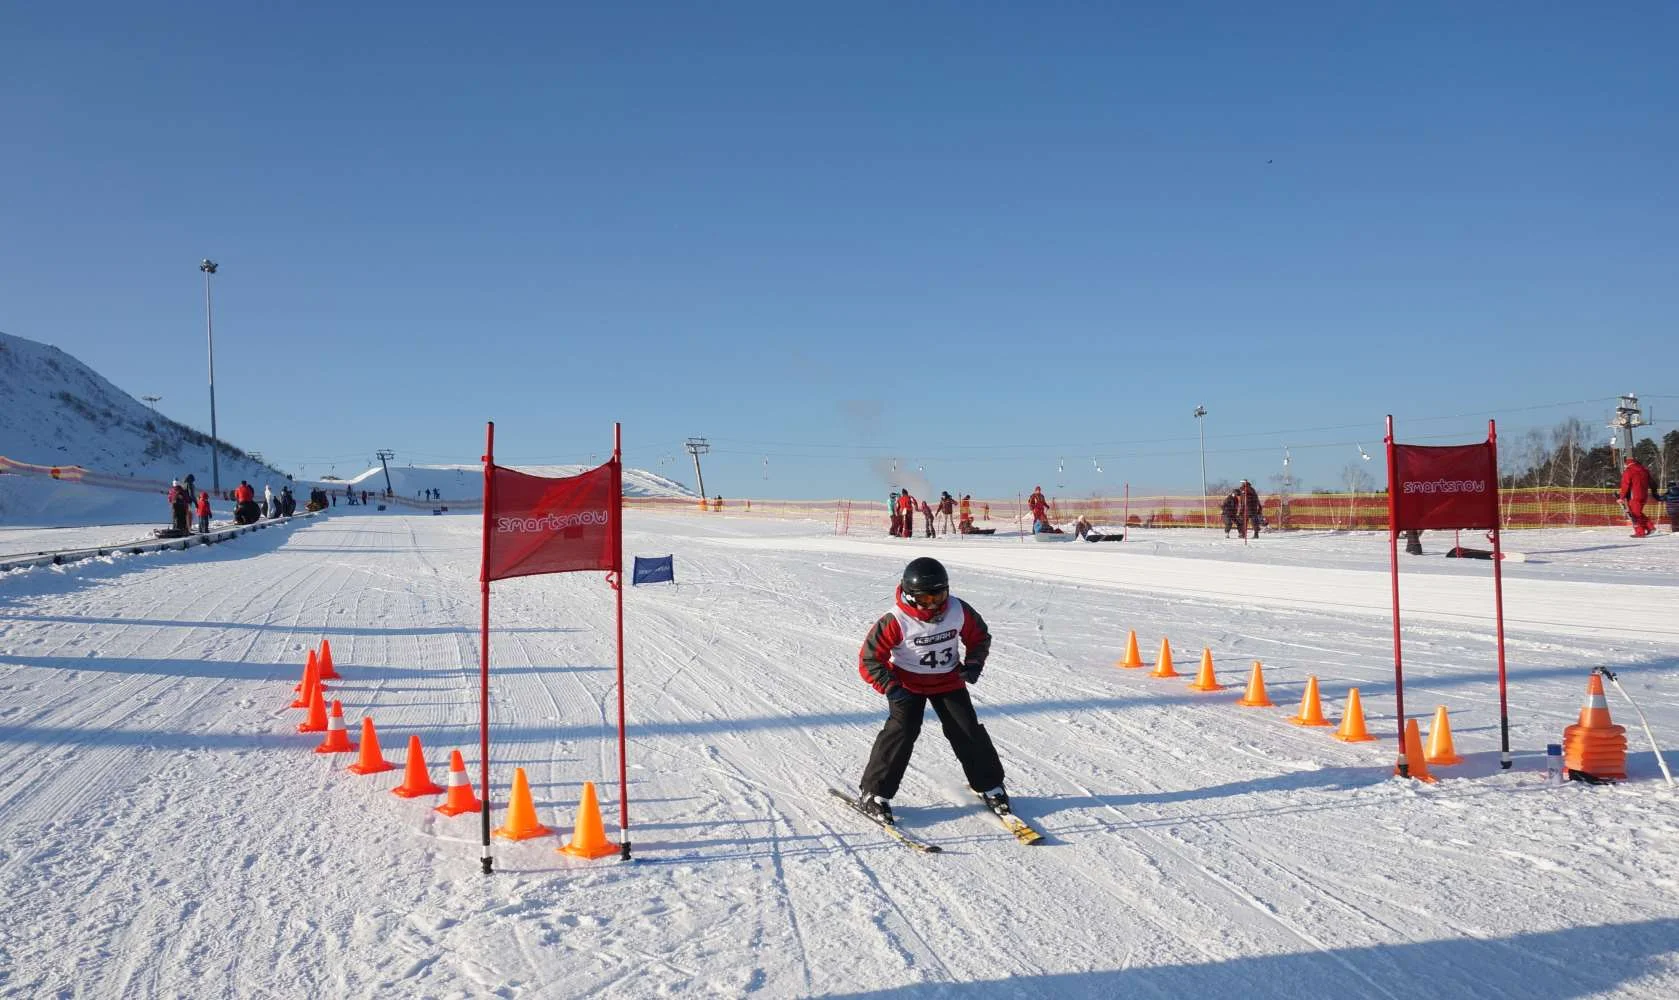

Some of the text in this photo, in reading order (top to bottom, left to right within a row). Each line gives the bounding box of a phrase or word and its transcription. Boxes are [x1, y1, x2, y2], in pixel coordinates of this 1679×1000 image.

[1403, 478, 1485, 494] smartsnow
[498, 511, 608, 533] smartsnow
[919, 647, 952, 669] 43
